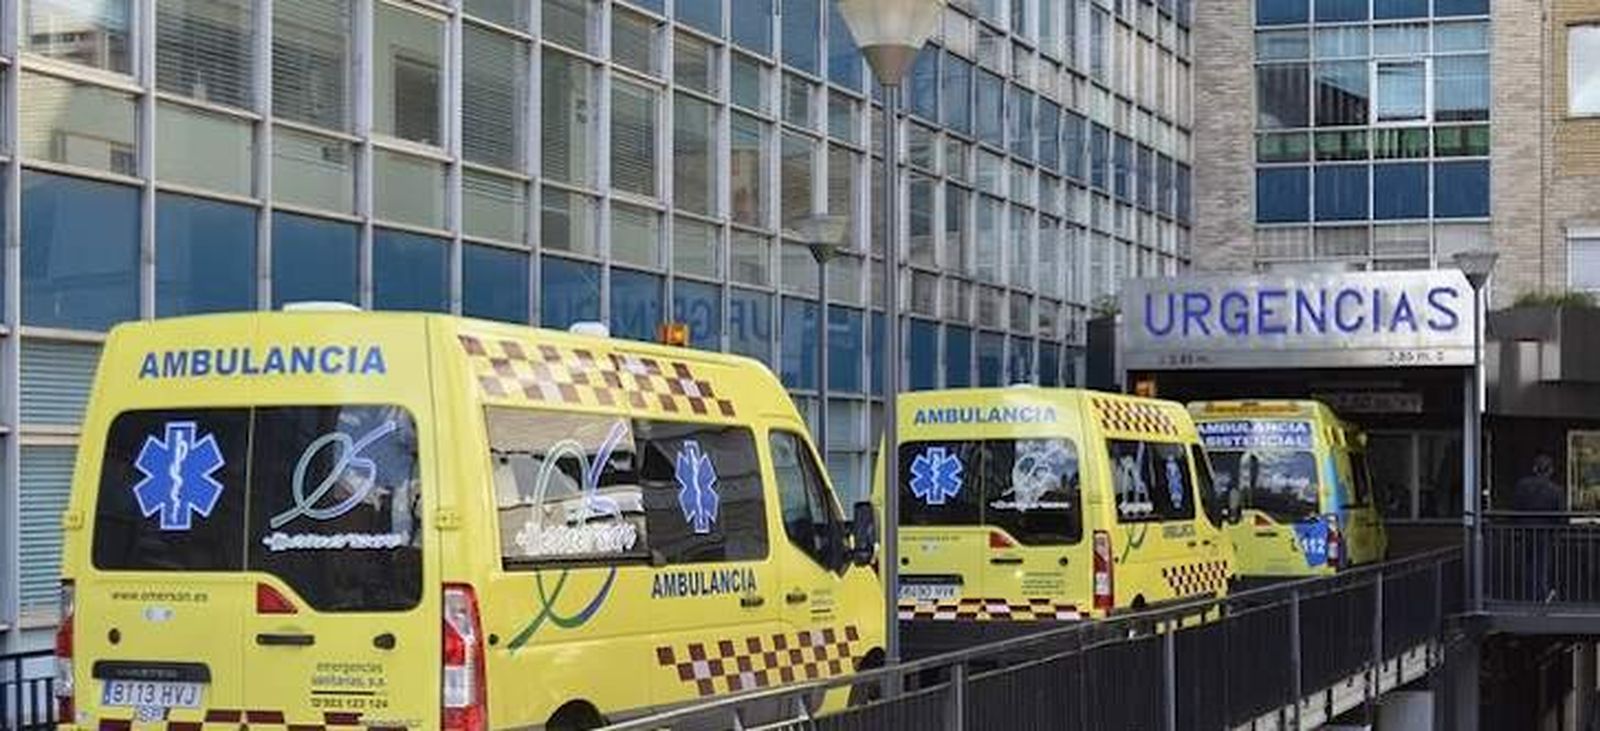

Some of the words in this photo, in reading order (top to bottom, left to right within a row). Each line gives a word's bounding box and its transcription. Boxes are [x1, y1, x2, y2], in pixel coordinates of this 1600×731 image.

[1144, 287, 1460, 337] URGENCIAS
[138, 345, 387, 379] AMBULANCIA
[913, 406, 1057, 425] AMBULANCIA
[1302, 537, 1327, 556] 112
[650, 567, 757, 600] AMBULANCIA
